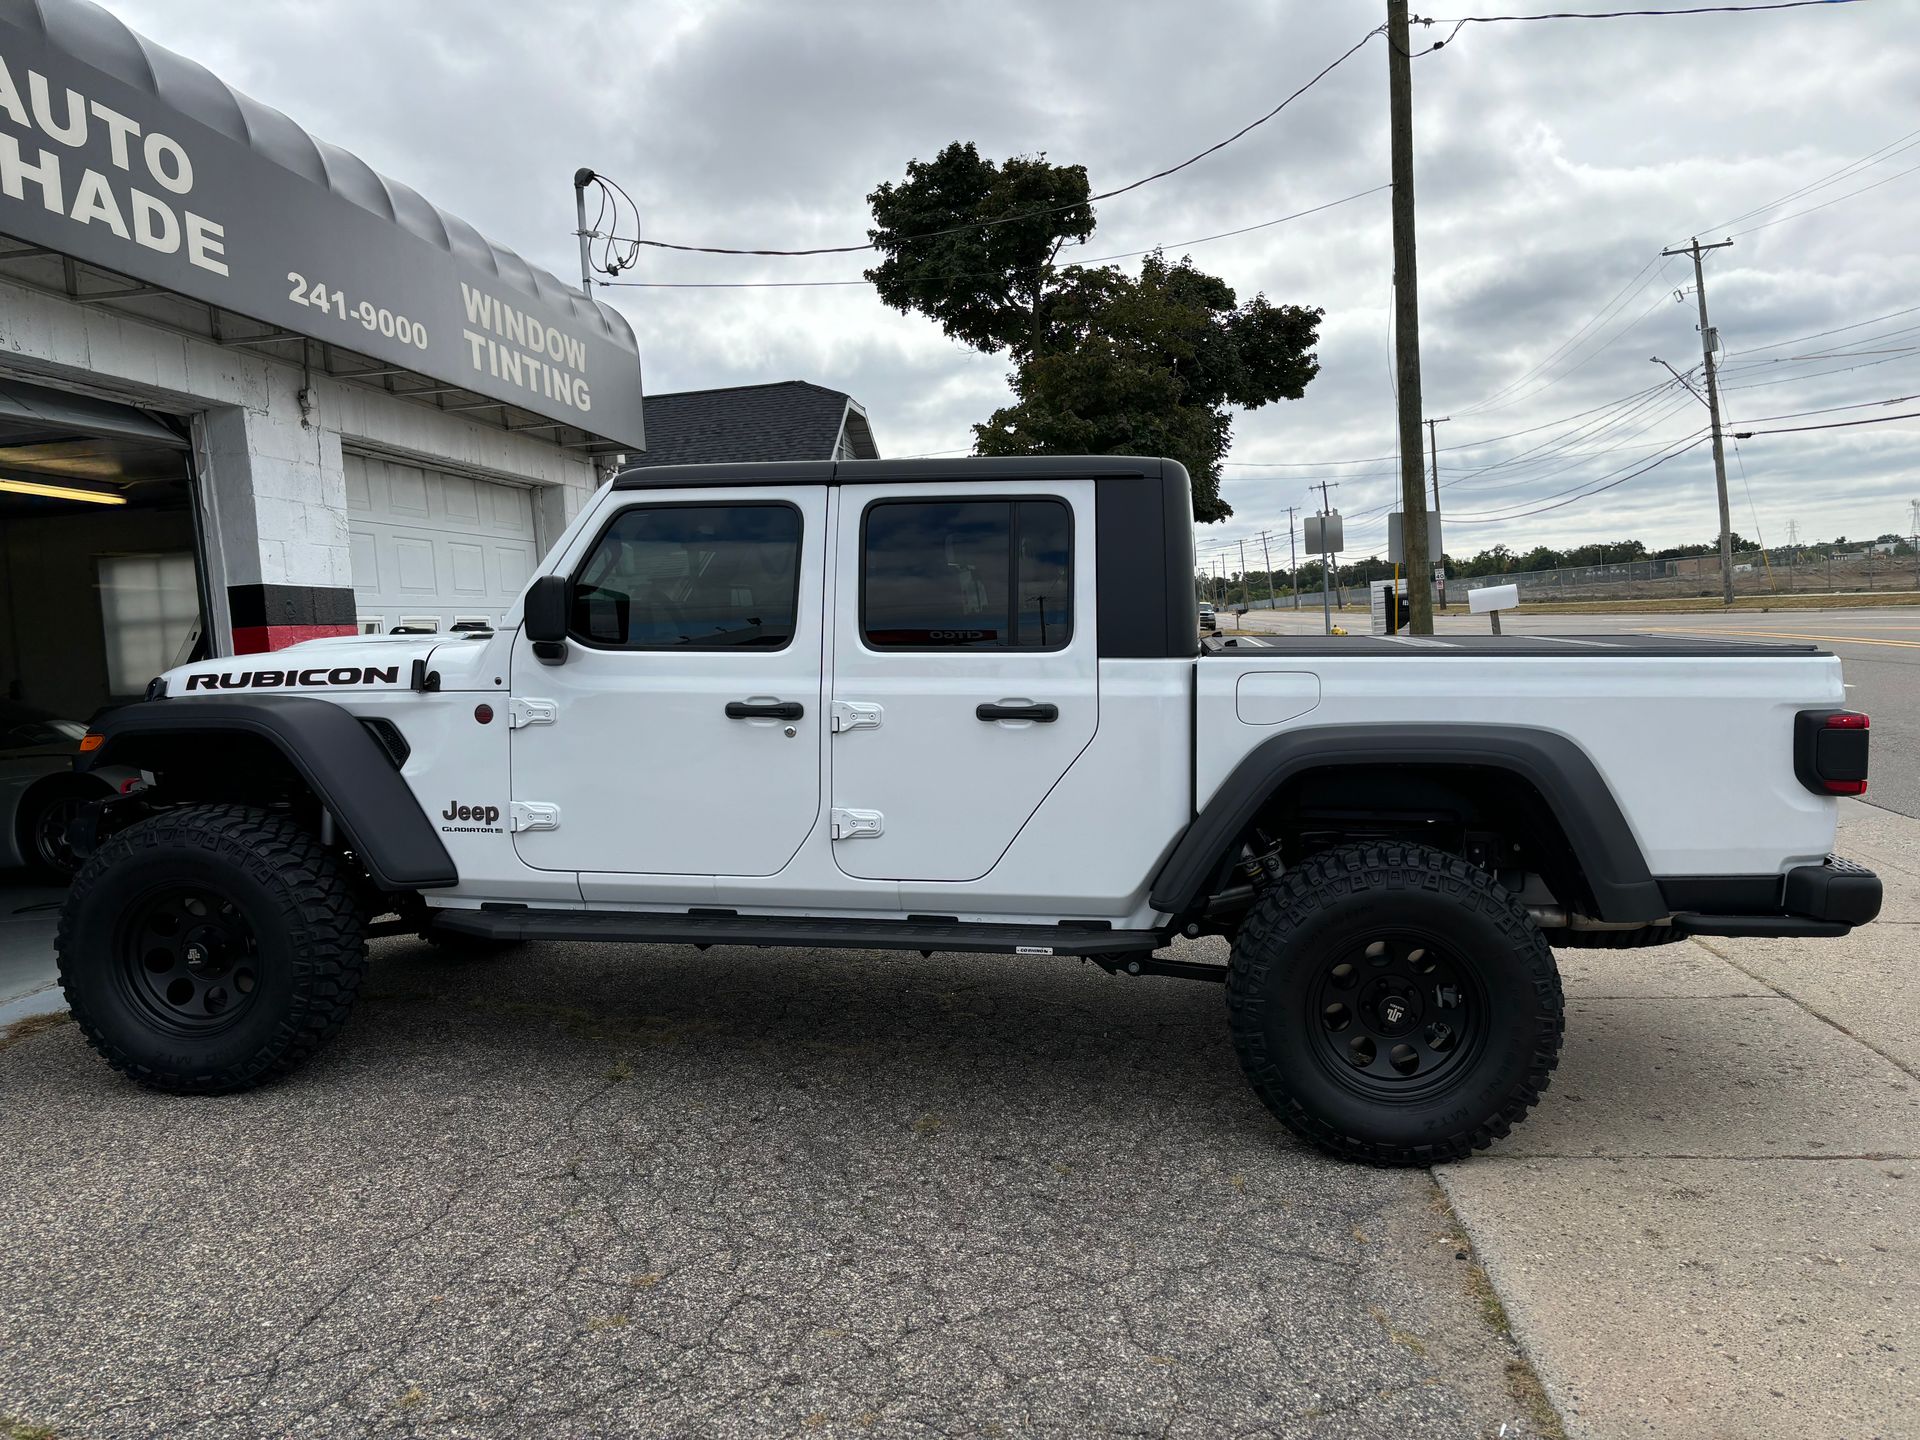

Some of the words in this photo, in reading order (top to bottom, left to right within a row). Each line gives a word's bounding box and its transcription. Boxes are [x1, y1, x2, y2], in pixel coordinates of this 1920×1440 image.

[287, 271, 428, 350] 241-9000
[460, 282, 586, 373] WINDOW
[463, 328, 591, 411] TINTING
[185, 666, 399, 690] RUBICON
[442, 800, 499, 826] Jeep
